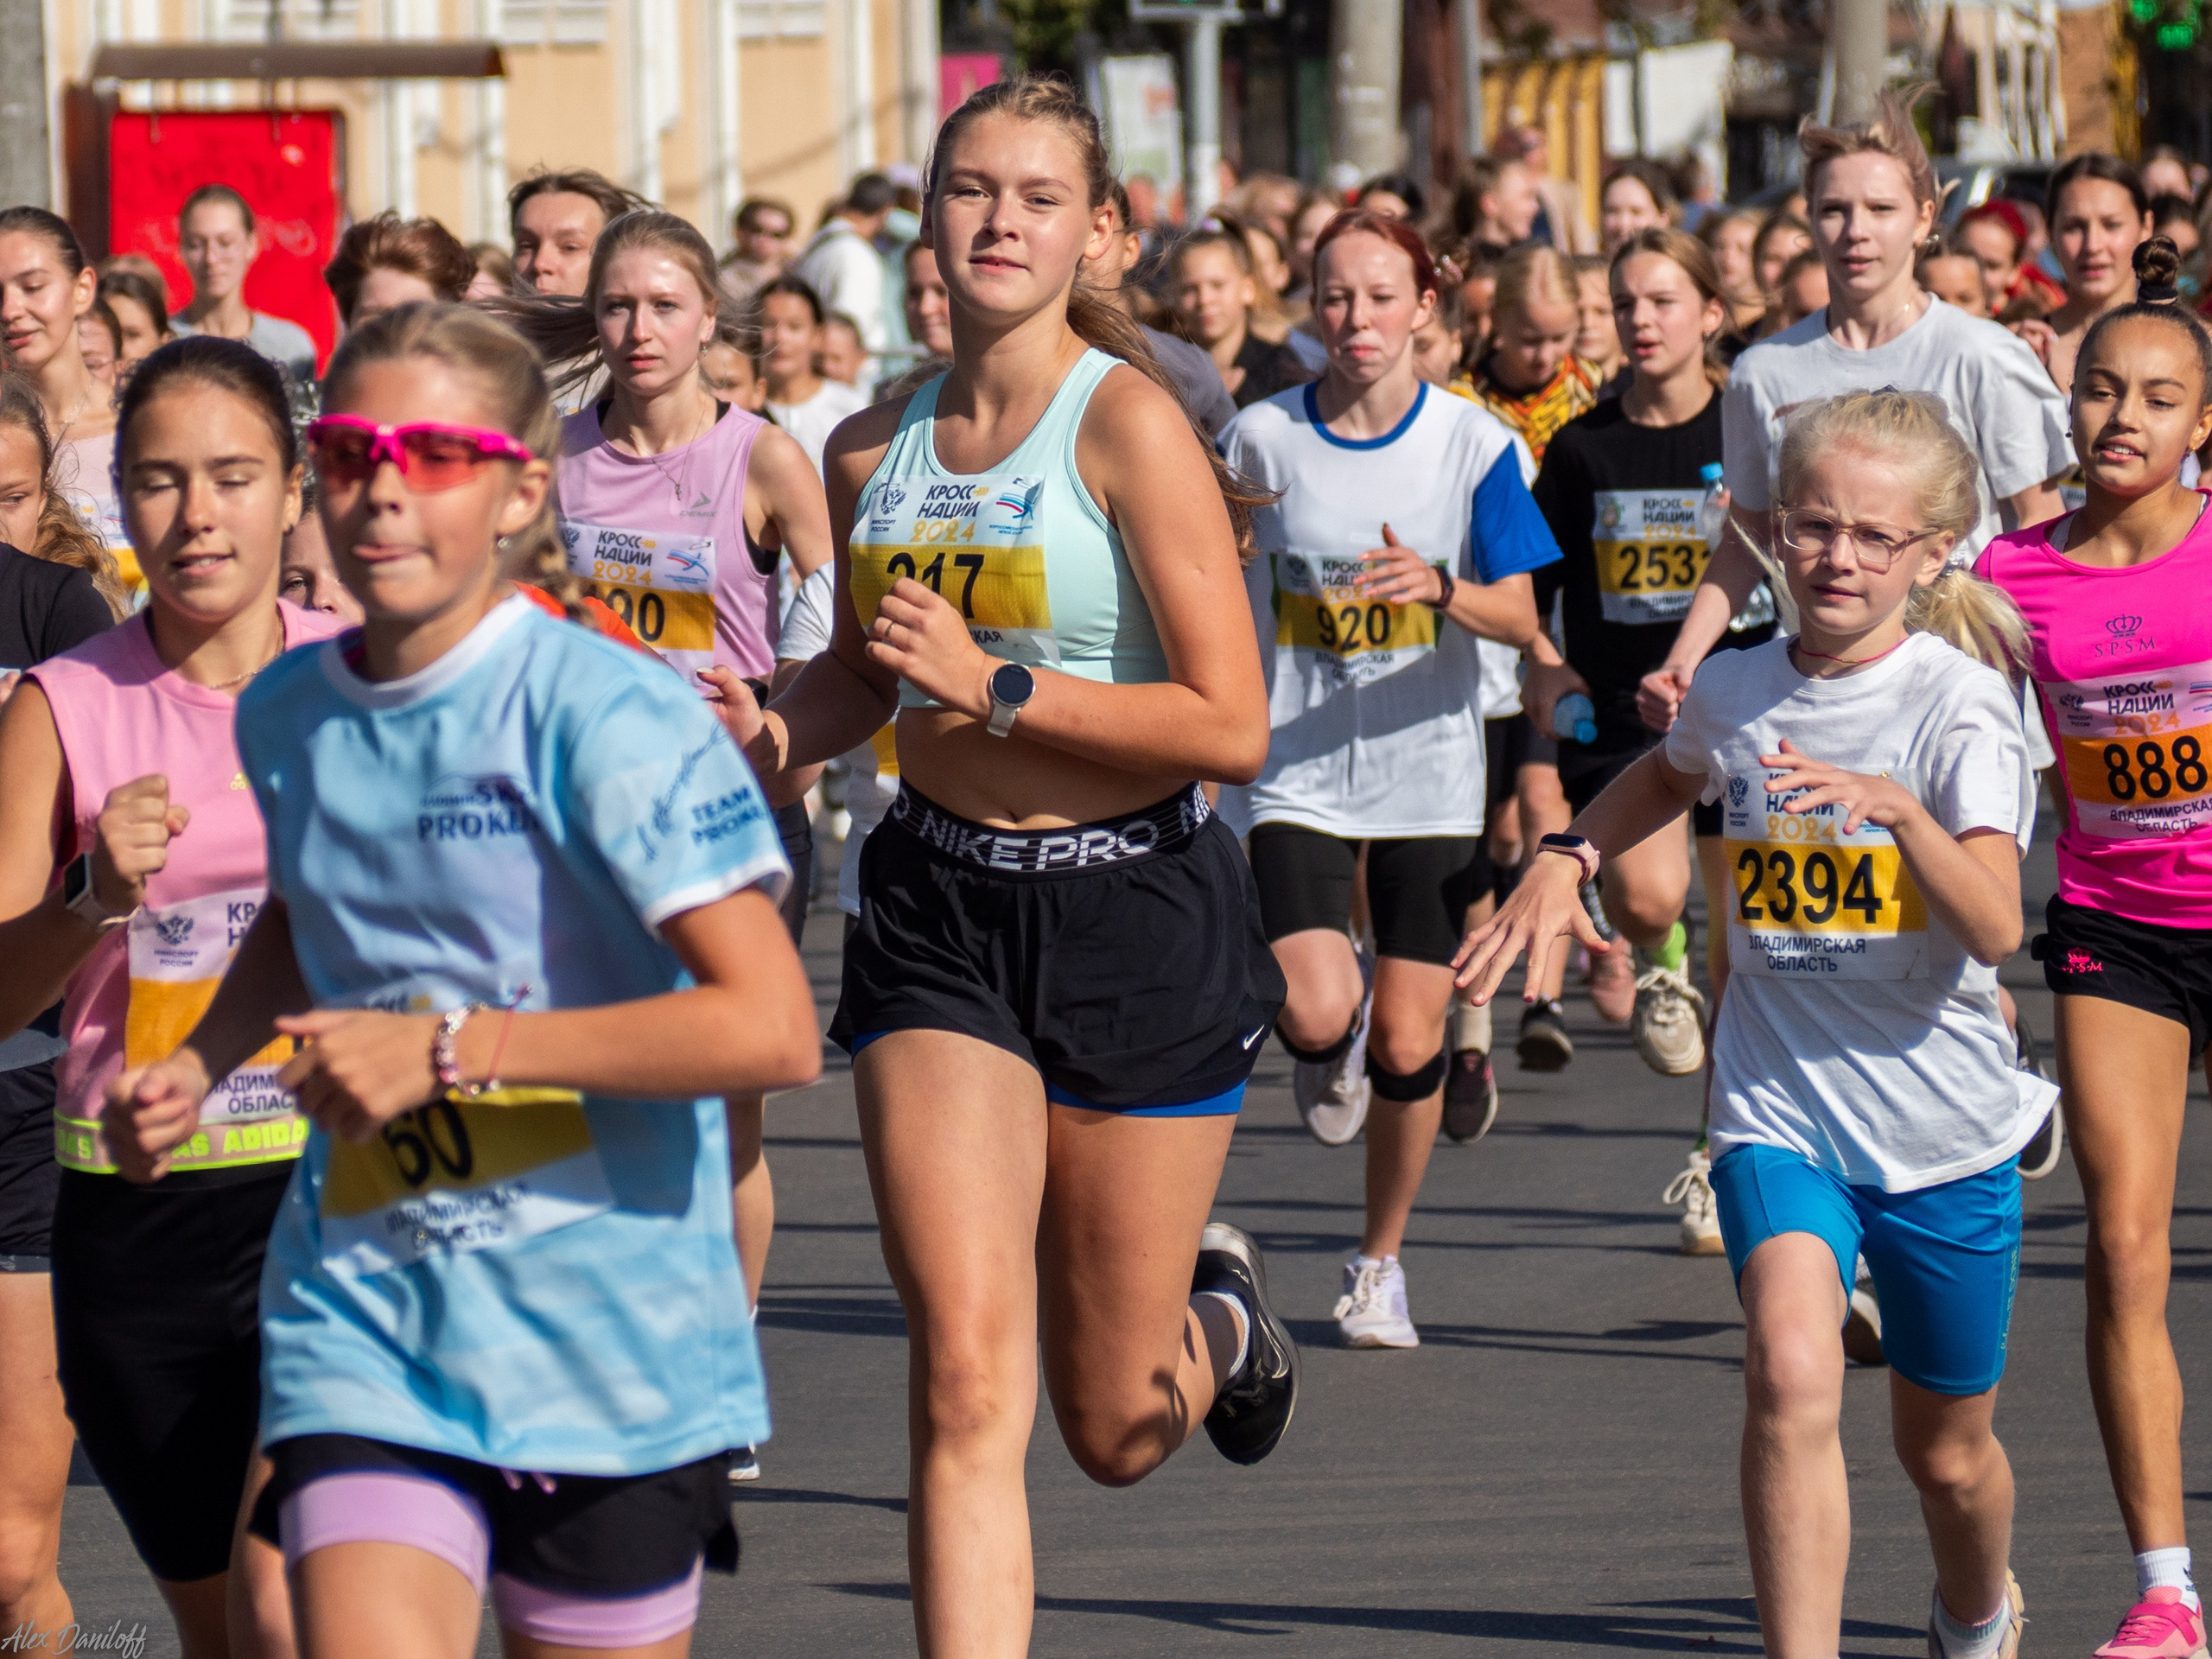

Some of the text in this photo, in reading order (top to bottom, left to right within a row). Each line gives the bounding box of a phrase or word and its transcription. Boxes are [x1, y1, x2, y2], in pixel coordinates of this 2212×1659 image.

[925, 485, 976, 500] КРОСС
[917, 501, 981, 518] НАЦИИ
[1643, 511, 1695, 522] НАЦИИ
[598, 530, 642, 549] КРОСС
[909, 520, 976, 542] 2024
[1643, 524, 1696, 538] 2024
[594, 545, 652, 566] НАЦИИ
[592, 560, 652, 585] 2024
[1323, 561, 1363, 573] КРОСС
[1620, 545, 1711, 589] 253
[1322, 573, 1355, 586] НАЦ
[1323, 584, 1363, 604] 202
[1317, 604, 1391, 652] 920
[2103, 681, 2157, 698] КРОСС
[2107, 693, 2174, 715] НАЦИИ
[2113, 710, 2180, 734] 2024
[2103, 735, 2208, 800] 888
[1767, 815, 1837, 842] 2024
[918, 810, 1160, 870] NIKE PRO
[1738, 848, 1882, 924] 2394
[1768, 955, 1837, 971] ОБЛАСТЬ
[228, 1092, 293, 1114] ОБЛАС
[223, 1119, 308, 1153] ADIDA
